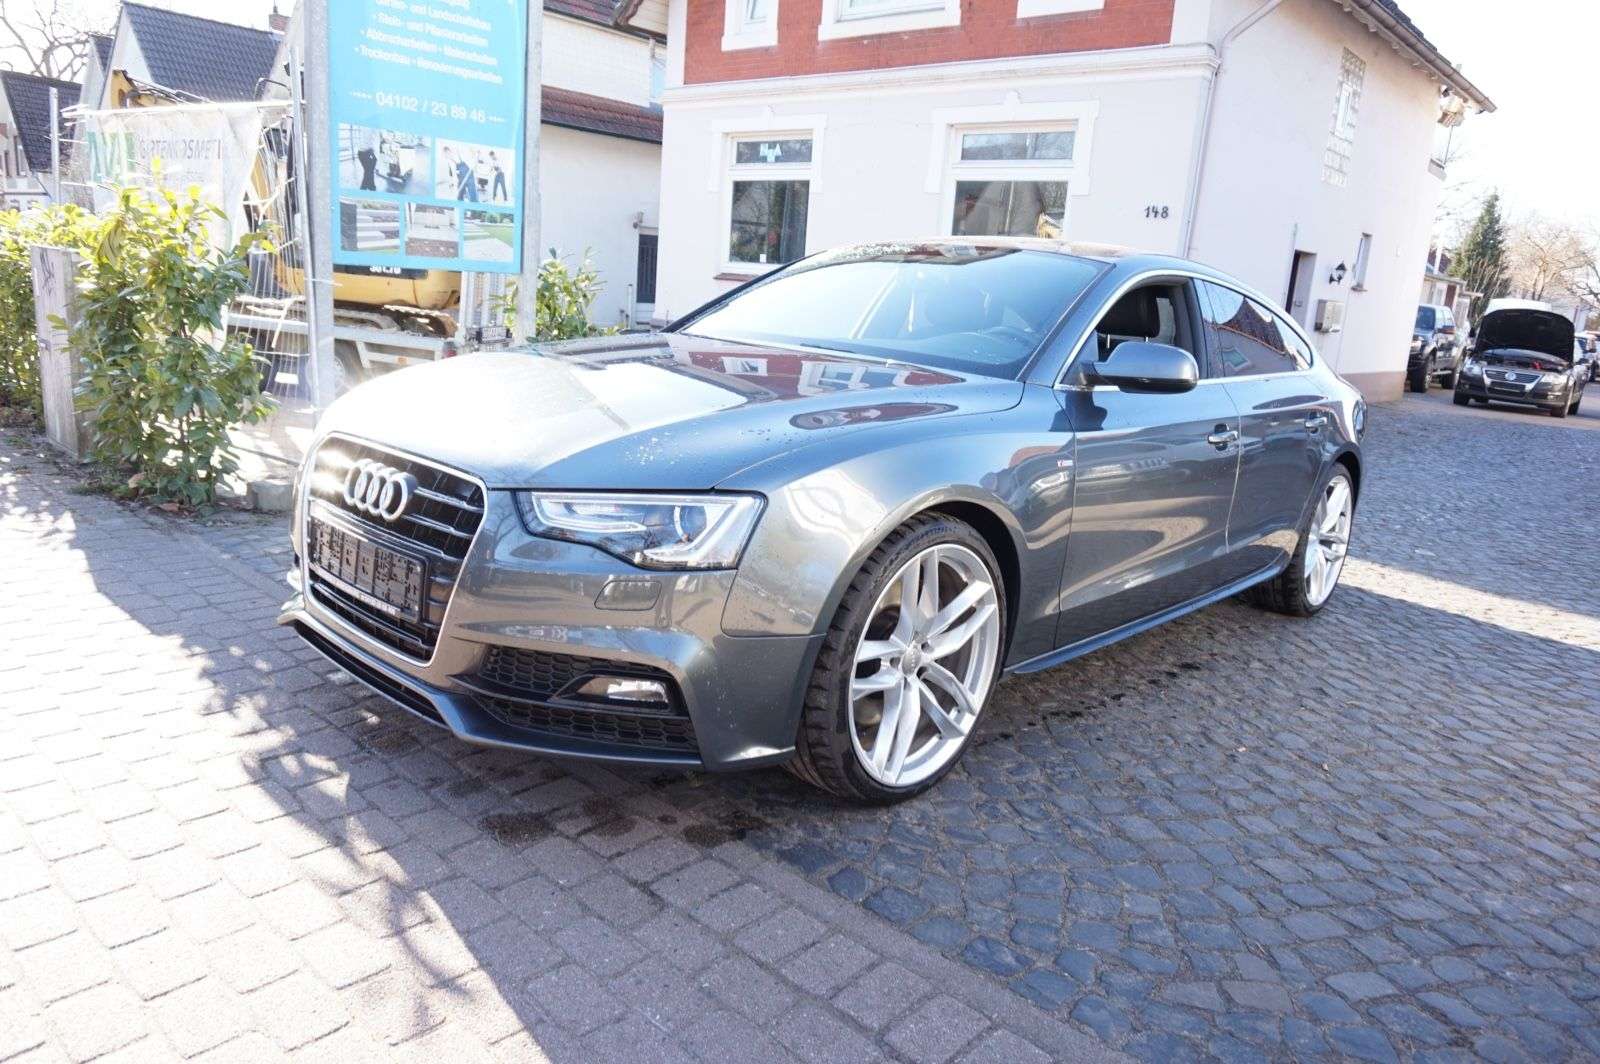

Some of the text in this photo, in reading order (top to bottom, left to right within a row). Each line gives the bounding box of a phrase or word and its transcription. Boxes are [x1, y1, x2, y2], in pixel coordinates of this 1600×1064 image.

[375, 90, 418, 112] 04102
[431, 100, 448, 117] 23
[1144, 205, 1169, 218] 148
